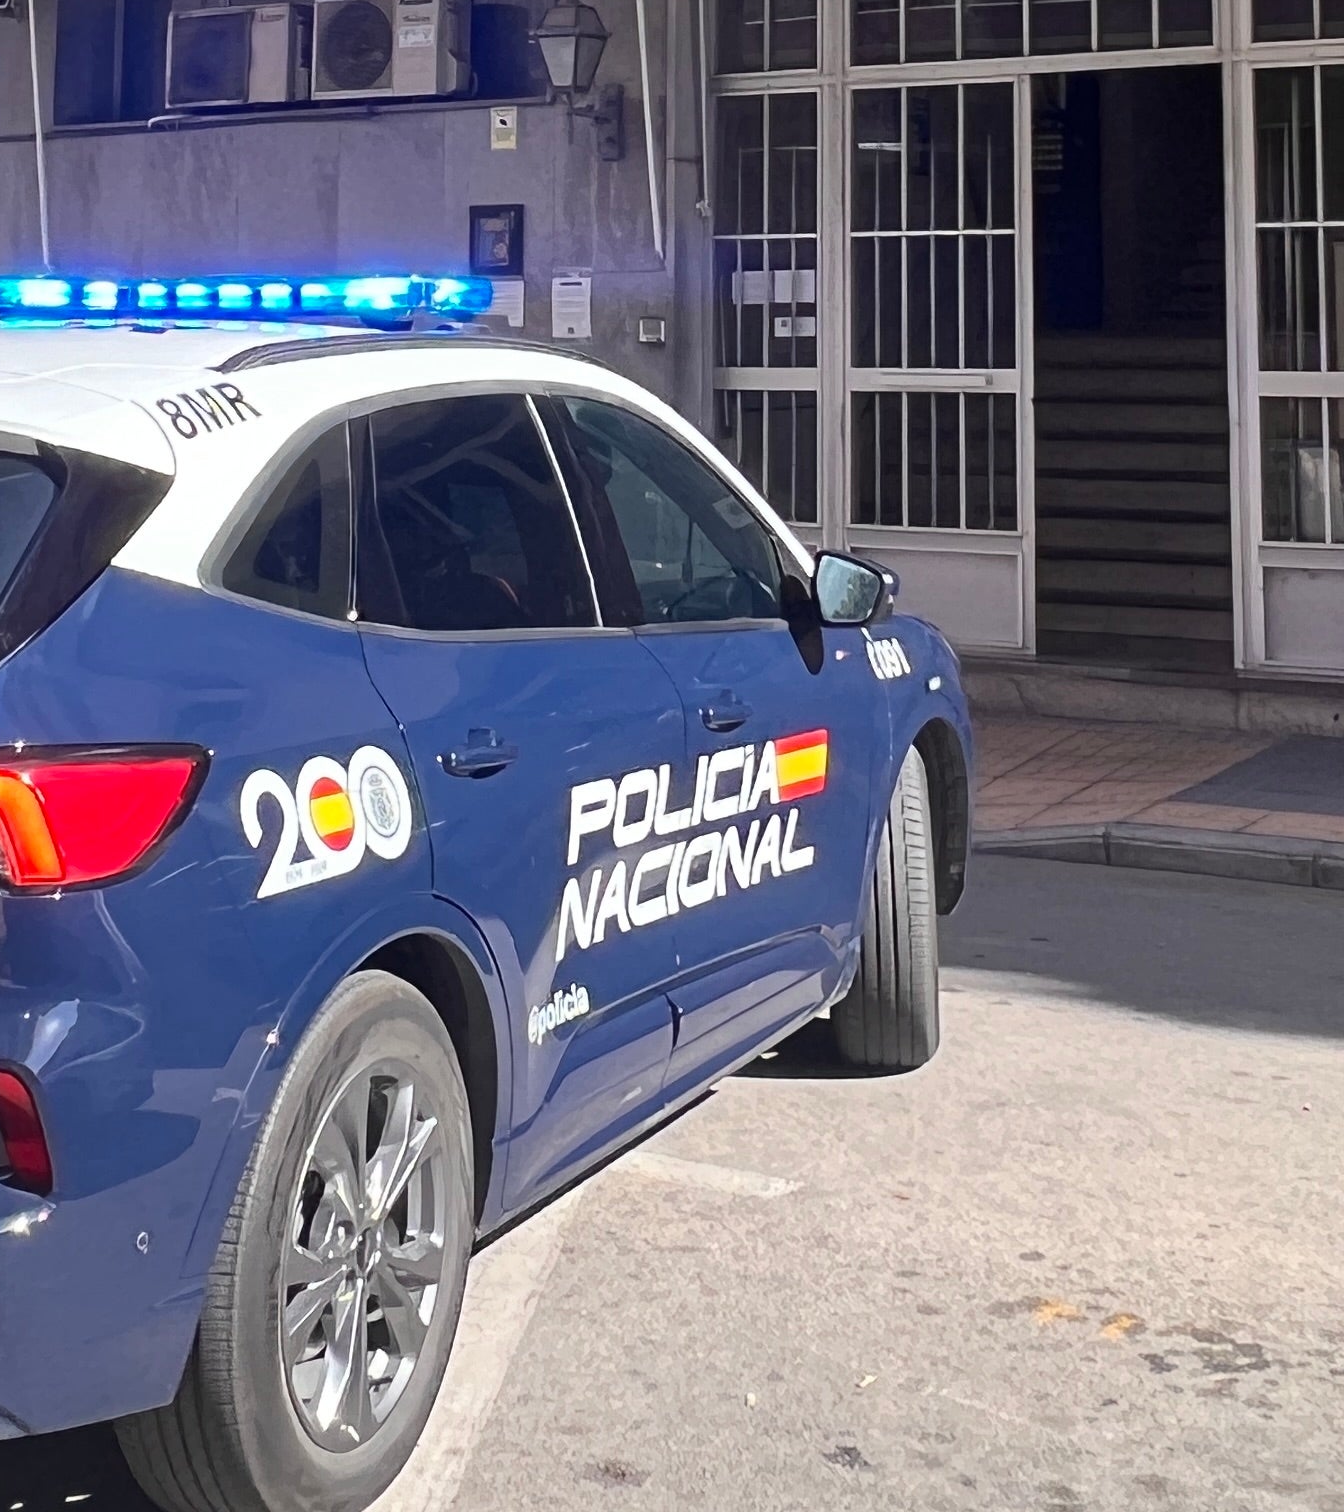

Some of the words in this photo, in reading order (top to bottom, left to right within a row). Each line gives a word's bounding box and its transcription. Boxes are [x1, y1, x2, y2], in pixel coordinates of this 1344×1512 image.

[155, 382, 263, 440] 8MR
[240, 744, 413, 900] 200
[555, 807, 815, 963] NACIONAL
